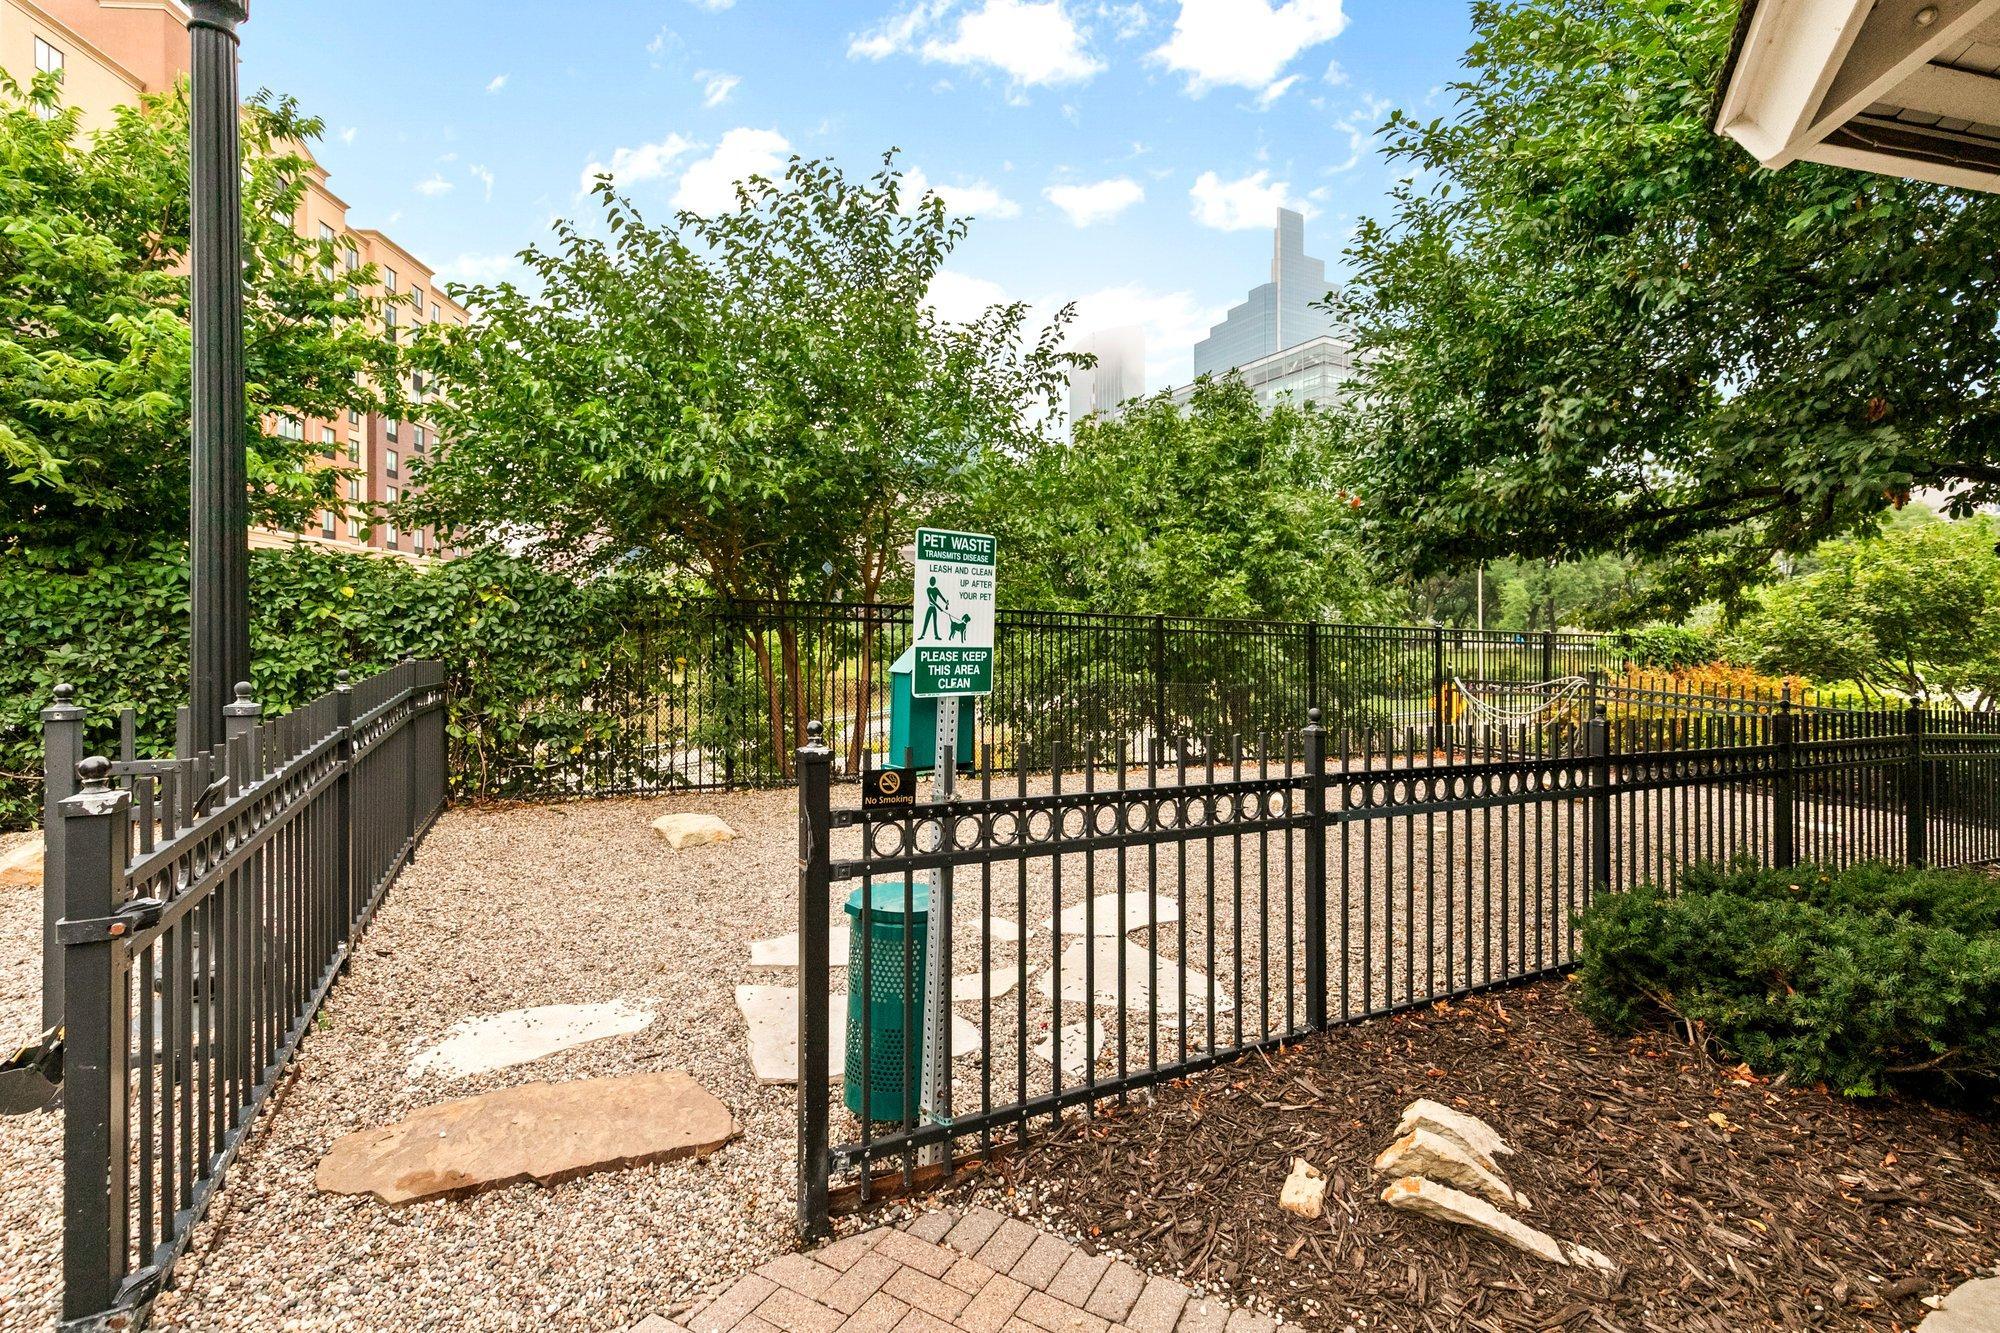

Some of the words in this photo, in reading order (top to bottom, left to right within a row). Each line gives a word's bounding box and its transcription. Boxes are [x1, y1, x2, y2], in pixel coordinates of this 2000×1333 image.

[923, 534, 946, 548] PET
[951, 537, 990, 552] WASTE
[925, 550, 961, 560] TRANSMITS
[962, 554, 988, 563] DISEASE
[930, 564, 952, 573] LEASH
[971, 568, 992, 576] CLEAN
[959, 592, 977, 600] YOUR
[921, 651, 958, 662] PLEASE
[962, 651, 987, 661] KEEP
[928, 665, 950, 675] THIS
[954, 665, 980, 675] AREA
[938, 678, 970, 689] CLEAN
[879, 795, 913, 804] Smoking
